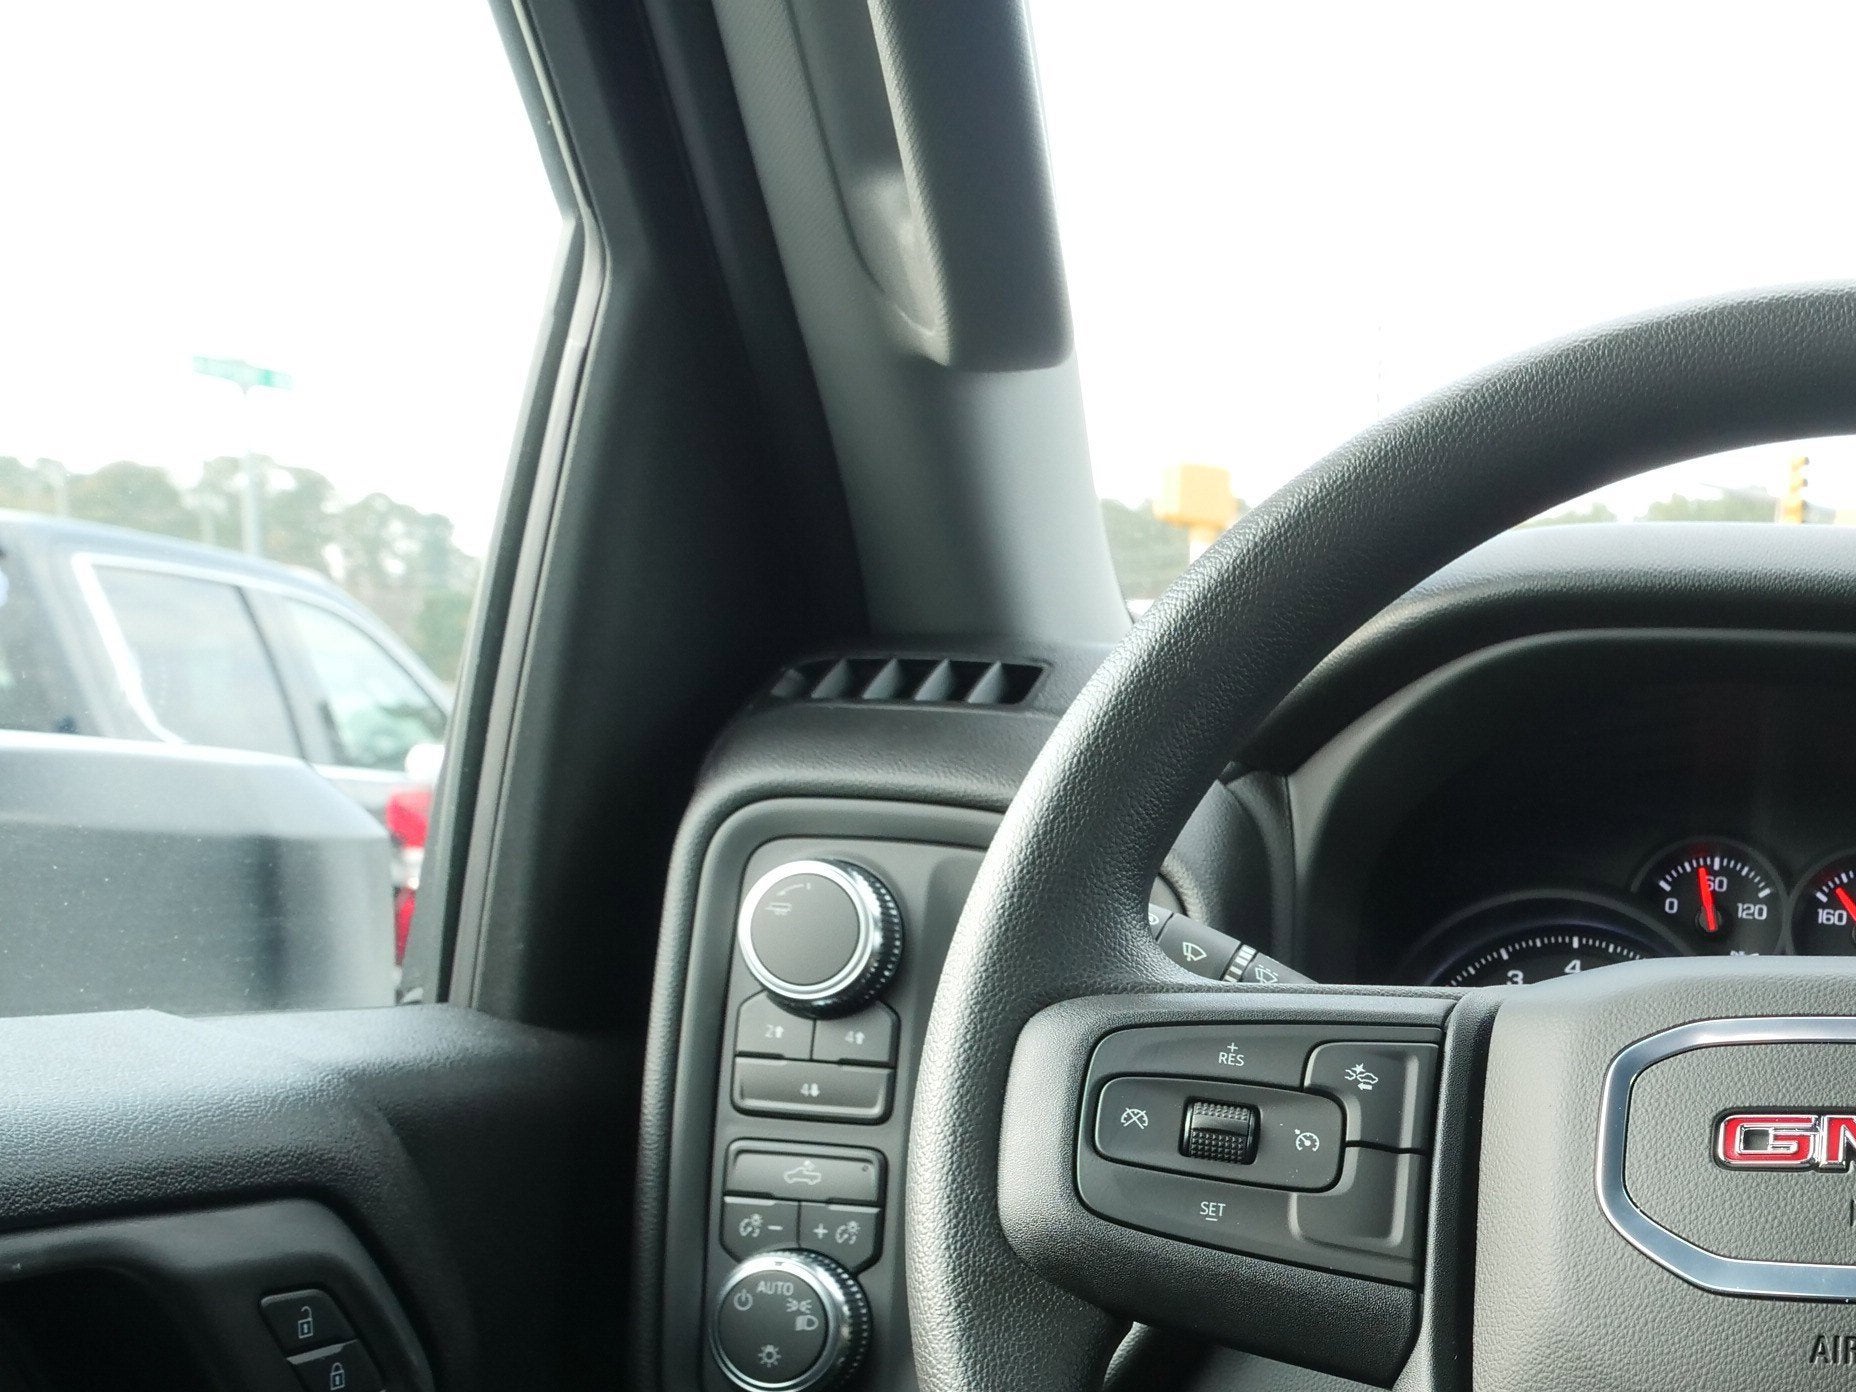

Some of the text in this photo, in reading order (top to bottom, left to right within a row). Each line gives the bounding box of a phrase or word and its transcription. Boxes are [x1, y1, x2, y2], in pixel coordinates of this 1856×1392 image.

[1664, 897, 1678, 914] 0
[1736, 902, 1768, 921] 120
[1816, 908, 1848, 927] 160
[1218, 1052, 1245, 1067] RES
[1200, 1201, 1226, 1216] SET
[756, 1280, 795, 1296] AUTO
